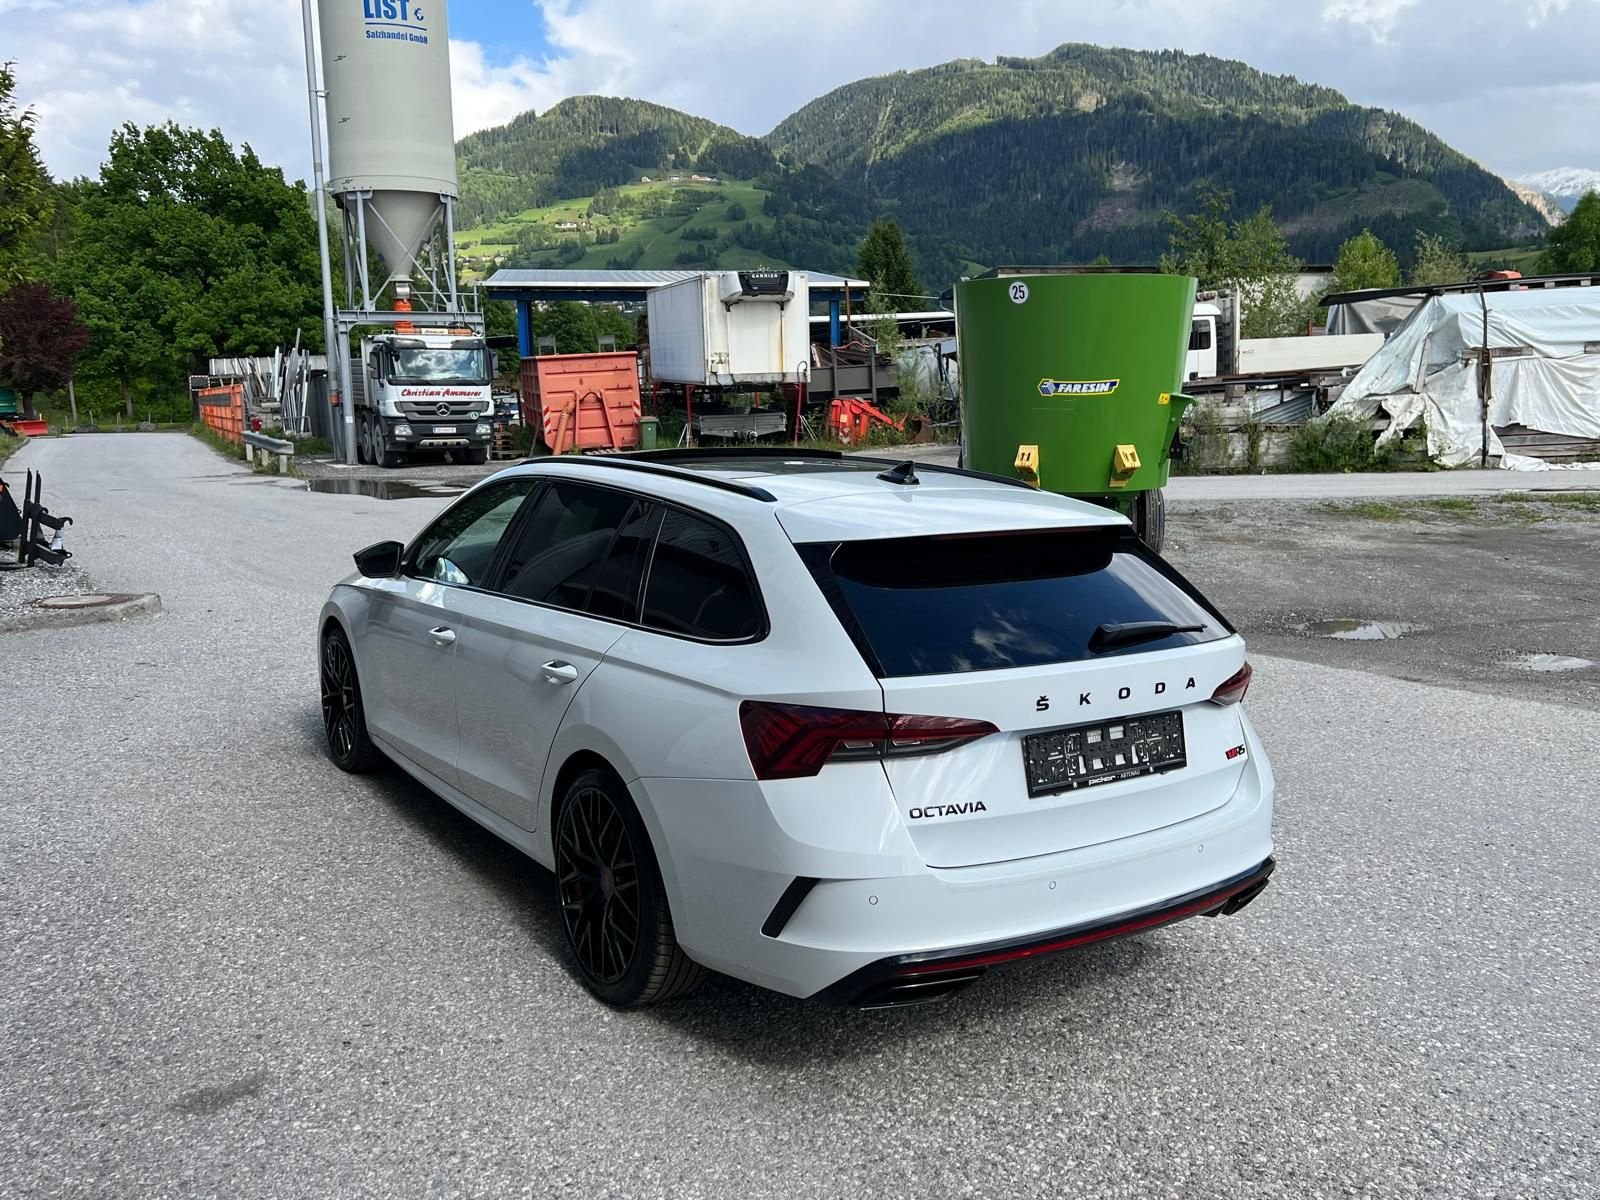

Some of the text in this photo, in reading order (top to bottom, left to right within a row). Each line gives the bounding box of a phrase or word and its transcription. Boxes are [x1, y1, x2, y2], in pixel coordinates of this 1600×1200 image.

[363, 0, 410, 20] LIST
[366, 30, 428, 44] Salzhandel GmbH
[1012, 285, 1025, 300] 25
[401, 388, 482, 397] Christian Ammerer
[1057, 382, 1111, 393] FARESIN
[909, 800, 987, 819] OCTAVIA
